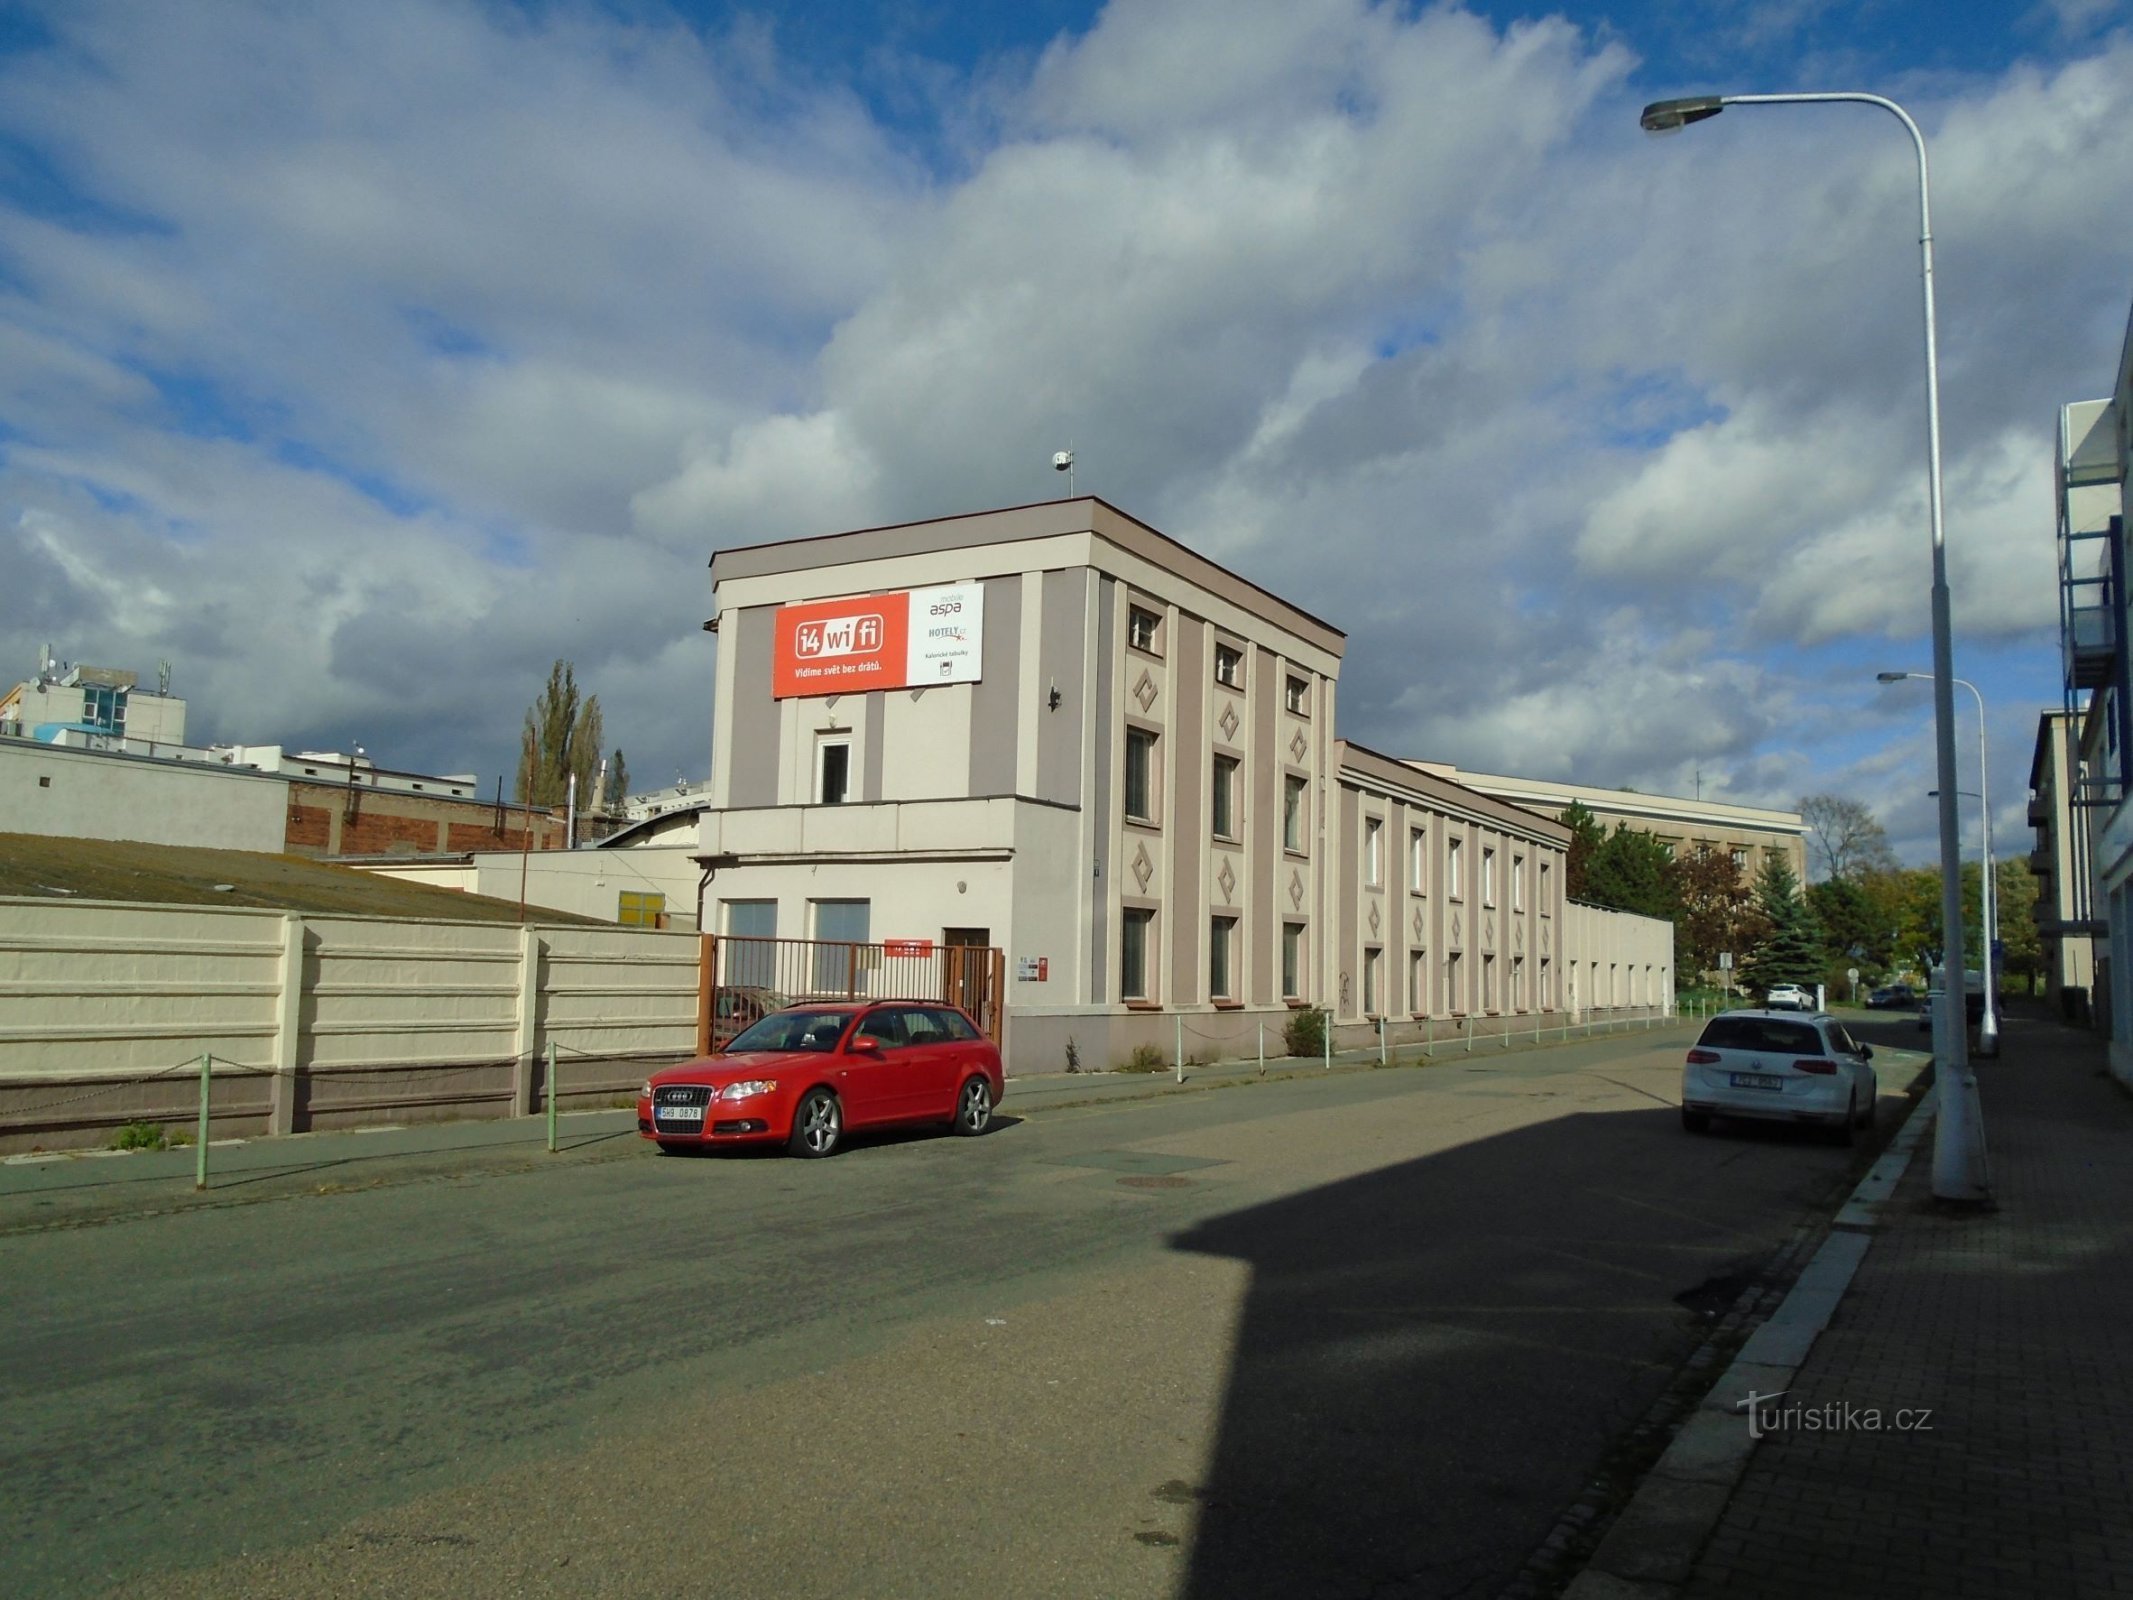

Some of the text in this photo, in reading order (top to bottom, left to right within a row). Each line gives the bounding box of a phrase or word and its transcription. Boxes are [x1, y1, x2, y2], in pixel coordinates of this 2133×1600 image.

[930, 602, 962, 617] aspa
[949, 649, 969, 657] tabulky
[824, 665, 841, 676] svět
[842, 664, 857, 674] bez
